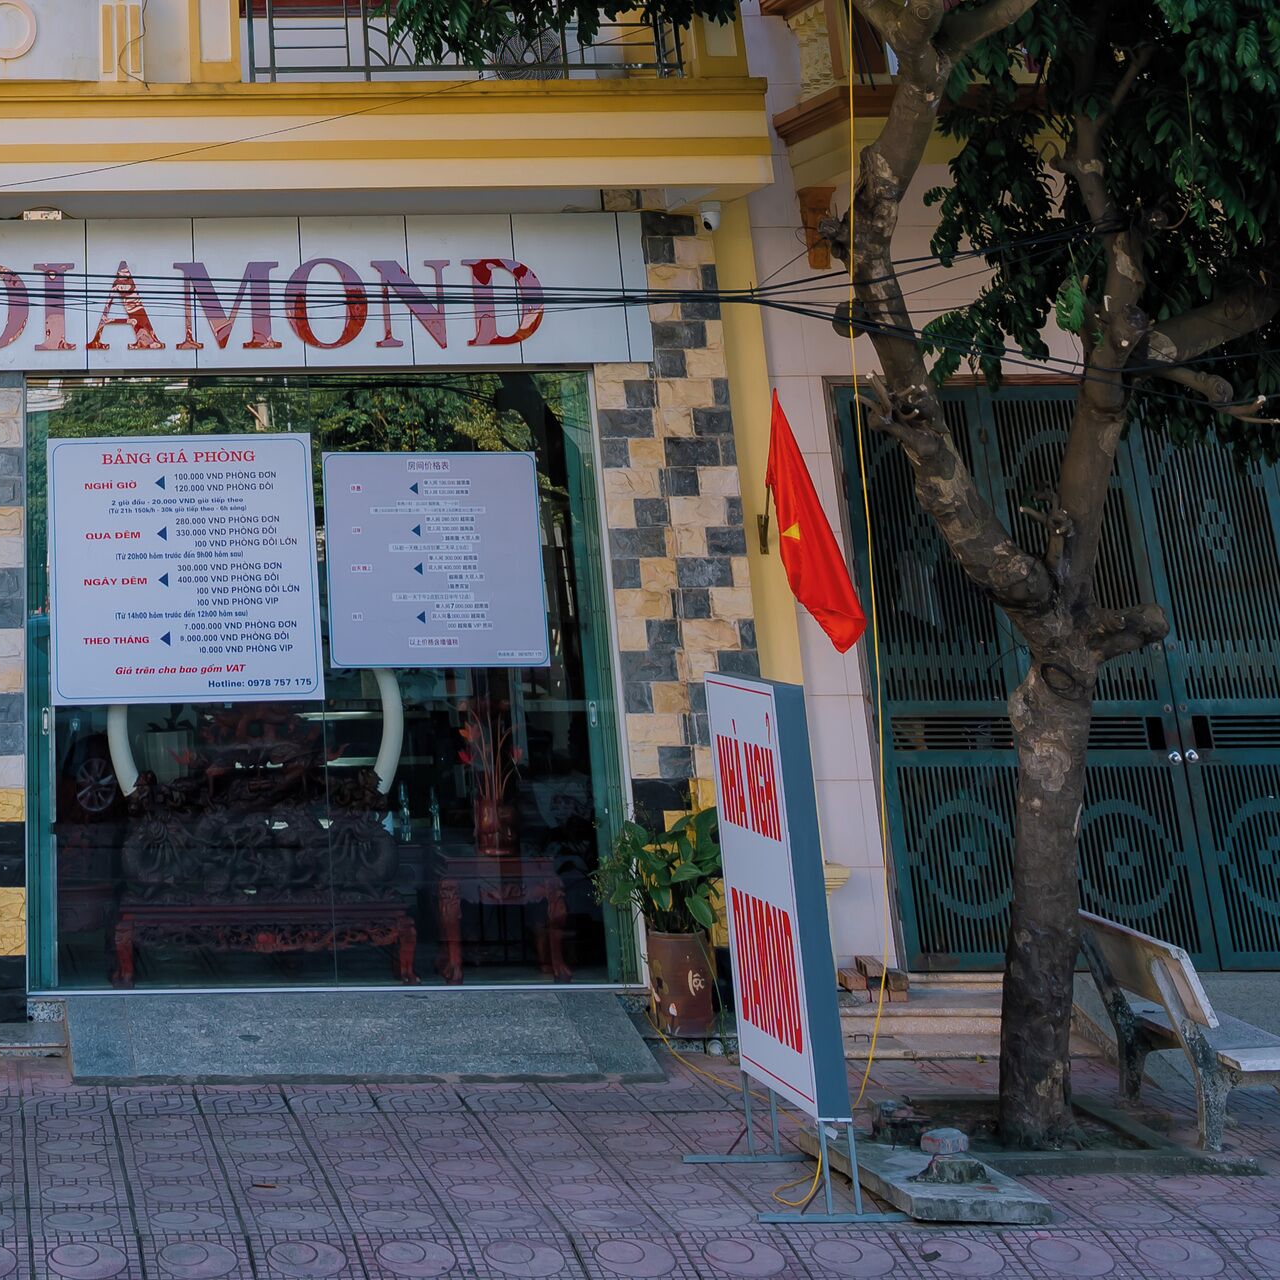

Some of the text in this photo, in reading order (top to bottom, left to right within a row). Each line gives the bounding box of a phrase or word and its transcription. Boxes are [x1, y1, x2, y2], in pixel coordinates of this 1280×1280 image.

[102, 448, 255, 464] BẢNG GIÁ PHÒNG
[226, 470, 256, 479] PHÒNG
[117, 480, 137, 489] GIỜ
[227, 482, 256, 491] PHÒNG
[259, 482, 274, 490] ĐÔI
[115, 530, 140, 539] ĐÊM
[229, 526, 259, 535] PHÒNG
[262, 526, 277, 534] ĐÔI
[230, 537, 260, 546] PHÒNG
[263, 537, 277, 545] ĐÔI
[177, 564, 208, 572] 300.000
[231, 561, 261, 570] PHÒNG
[84, 576, 147, 586] NGÀY ĐÊM
[231, 573, 261, 581] PHÒNG
[264, 573, 279, 581] ĐÔI
[232, 585, 262, 593] PHÒNG
[265, 584, 280, 592] ĐÔI
[232, 597, 263, 605] PHÒNG
[245, 619, 275, 629] PHÒNG
[278, 620, 297, 628] ĐƠN
[83, 635, 149, 645] THEO THÁNG
[241, 631, 271, 640] PHÒNG
[274, 631, 289, 640] ĐÔI
[246, 643, 277, 652] PHÒNG
[116, 667, 132, 675] Giá
[201, 664, 222, 675] gồm
[226, 664, 246, 672] VAT
[716, 712, 782, 841] NHÀ NGHỈ
[731, 887, 803, 1054] DIAMOND
